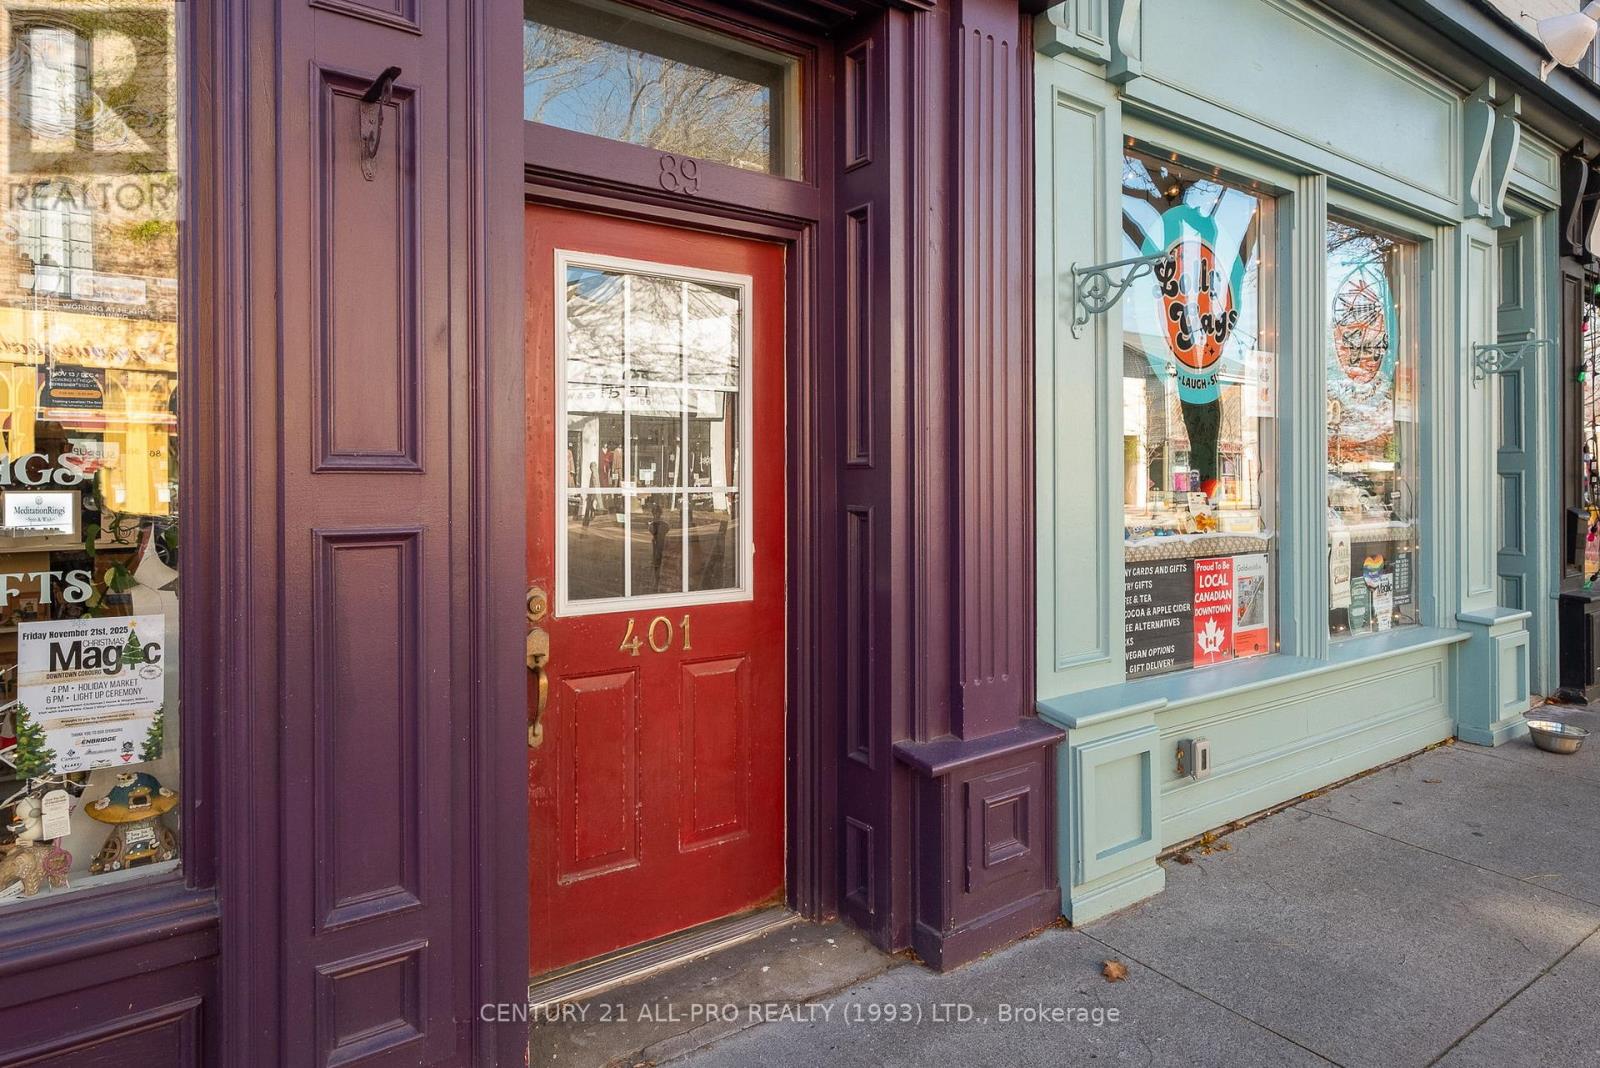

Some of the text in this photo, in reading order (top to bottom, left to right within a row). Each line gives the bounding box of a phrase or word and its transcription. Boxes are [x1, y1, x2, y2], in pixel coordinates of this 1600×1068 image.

[658, 153, 701, 197] 89
[1181, 375, 1207, 389] LAUGH
[1132, 566, 1154, 576] CARDS
[1154, 565, 1169, 575] AND
[1169, 563, 1188, 573] GIFTS
[1196, 561, 1214, 572] Proud
[1215, 561, 1222, 570] To
[1222, 560, 1230, 570] Be
[1134, 580, 1153, 590] GIFTS
[1199, 573, 1229, 589] LOCAL
[1133, 595, 1139, 604] &
[1139, 593, 1153, 603] TEA
[1194, 589, 1232, 604] CANADIAN
[1146, 607, 1152, 616] &
[1152, 605, 1173, 616] APPLE
[1172, 603, 1191, 613] CIDER
[1194, 604, 1231, 616] DOWNTOWN
[1134, 617, 1181, 631] ALTERNATIVES
[22, 626, 129, 640] Friday November 21st, 2025
[618, 614, 693, 657] 401
[82, 637, 125, 647] CHRISTMAS
[1125, 644, 1175, 660] VEGAN OPTIONS
[1129, 658, 1175, 673] GIFT DELIVERY
[46, 672, 77, 680] DOWNTOWN
[57, 685, 69, 693] PM
[78, 682, 108, 691] HOLIDAY
[109, 678, 138, 689] MARKET
[46, 696, 51, 704] 6
[52, 695, 64, 703] PM
[73, 692, 93, 701] LIGHT
[94, 691, 105, 699] UP
[105, 687, 143, 698] CEREMONY
[81, 736, 117, 745] ENBRIDGE
